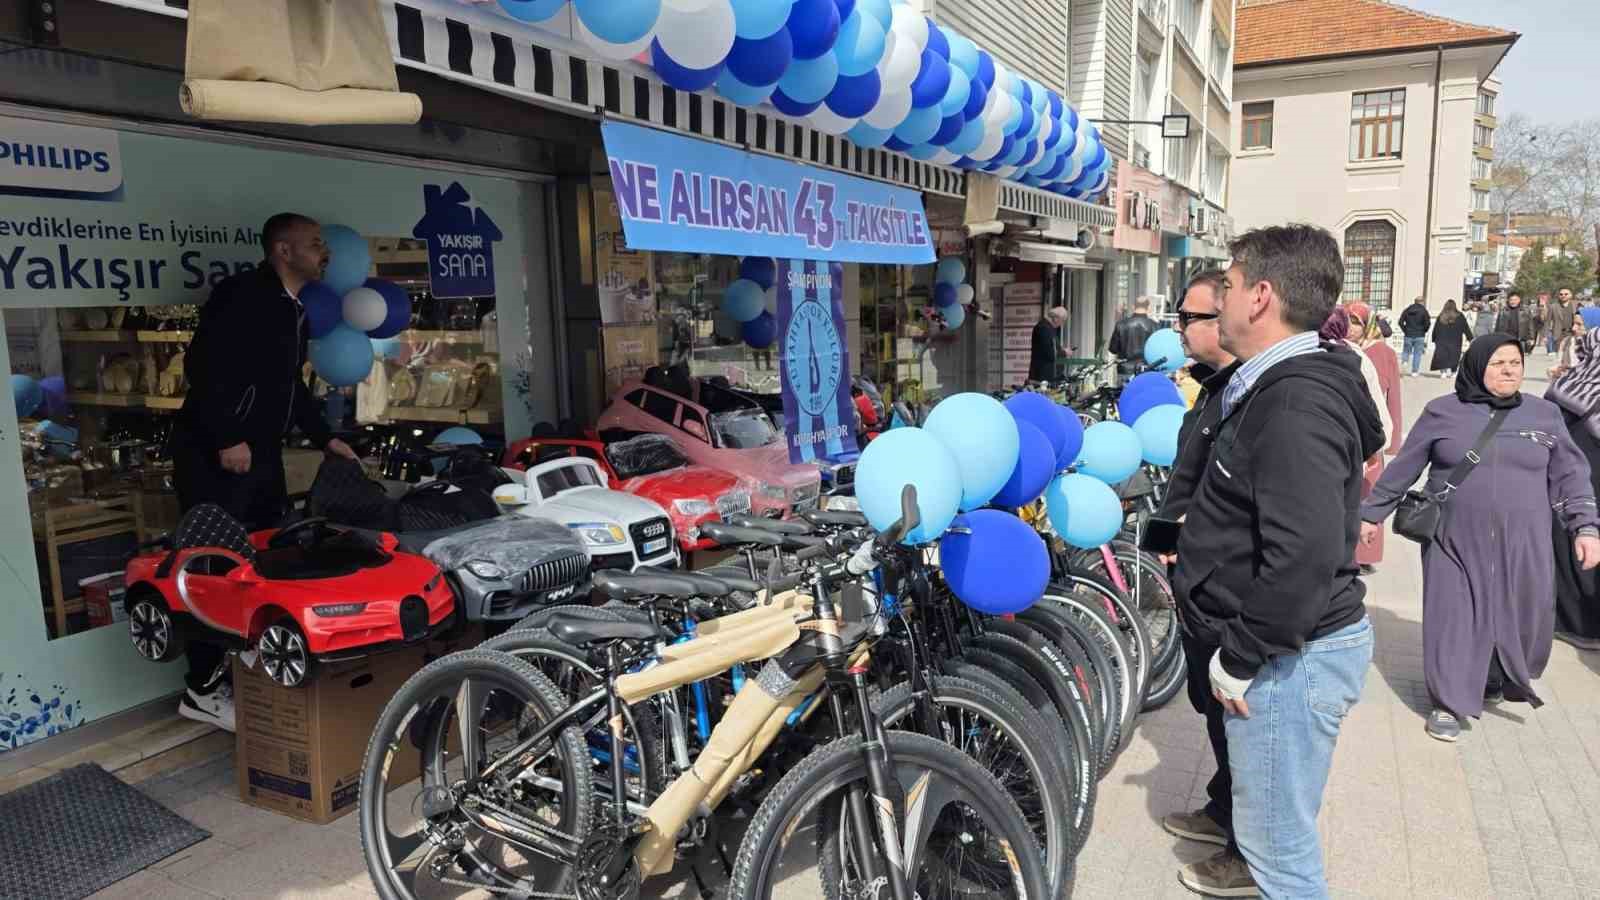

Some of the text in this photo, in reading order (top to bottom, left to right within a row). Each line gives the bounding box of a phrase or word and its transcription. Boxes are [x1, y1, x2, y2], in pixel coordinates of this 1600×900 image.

[608, 156, 663, 223] NE
[668, 169, 791, 236] ALIRSAN
[847, 194, 929, 246] TAKSİTLE
[139, 223, 164, 241] En
[170, 220, 228, 247] İyisini
[437, 233, 483, 250] YAKIŞIR
[0, 244, 167, 301] Yakışır
[439, 254, 487, 277] SANA
